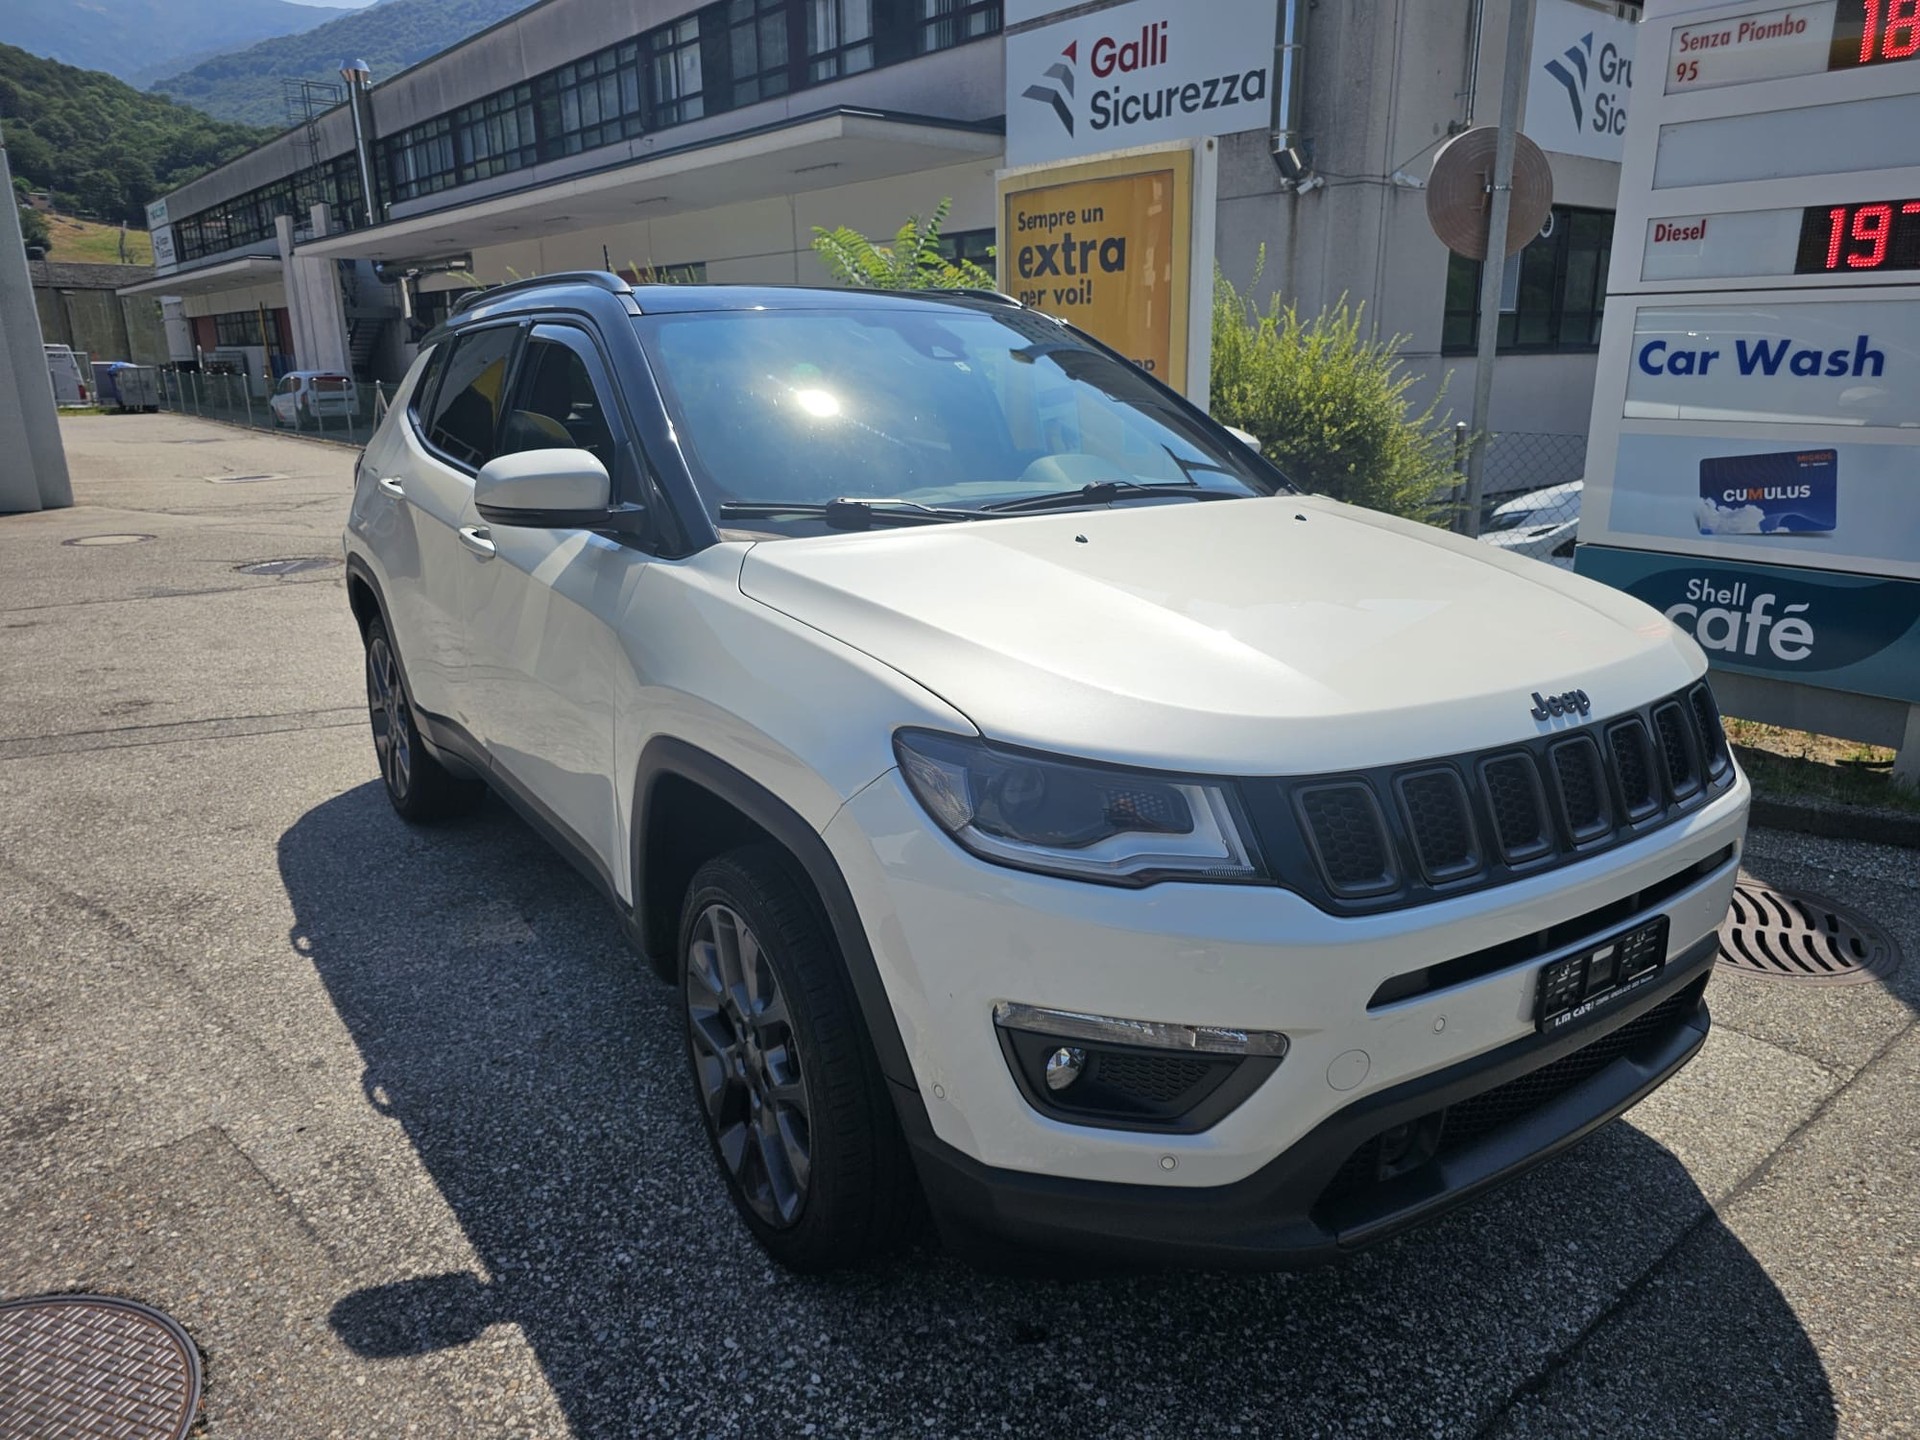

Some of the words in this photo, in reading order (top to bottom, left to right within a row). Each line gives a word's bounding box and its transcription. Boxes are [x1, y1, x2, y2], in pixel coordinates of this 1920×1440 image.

[1680, 31, 1732, 52] Senza
[1737, 14, 1807, 43] Piombo
[1859, 0, 1920, 62] 18
[1091, 20, 1168, 78] Galli
[1677, 61, 1699, 82] 95
[1090, 68, 1267, 131] Sicurezza
[1593, 92, 1626, 136] Sic
[1018, 210, 1076, 234] Sempre
[1082, 207, 1104, 223] un
[1654, 219, 1706, 243] Diesel
[1018, 232, 1126, 279] extra
[1020, 289, 1046, 306] per
[1053, 278, 1092, 305] voi!
[1638, 340, 1719, 376] Car
[1735, 335, 1885, 377] Wash
[1722, 485, 1811, 502] CUMULUS
[1686, 578, 1746, 605] Shell
[1530, 689, 1590, 721] Jeep
